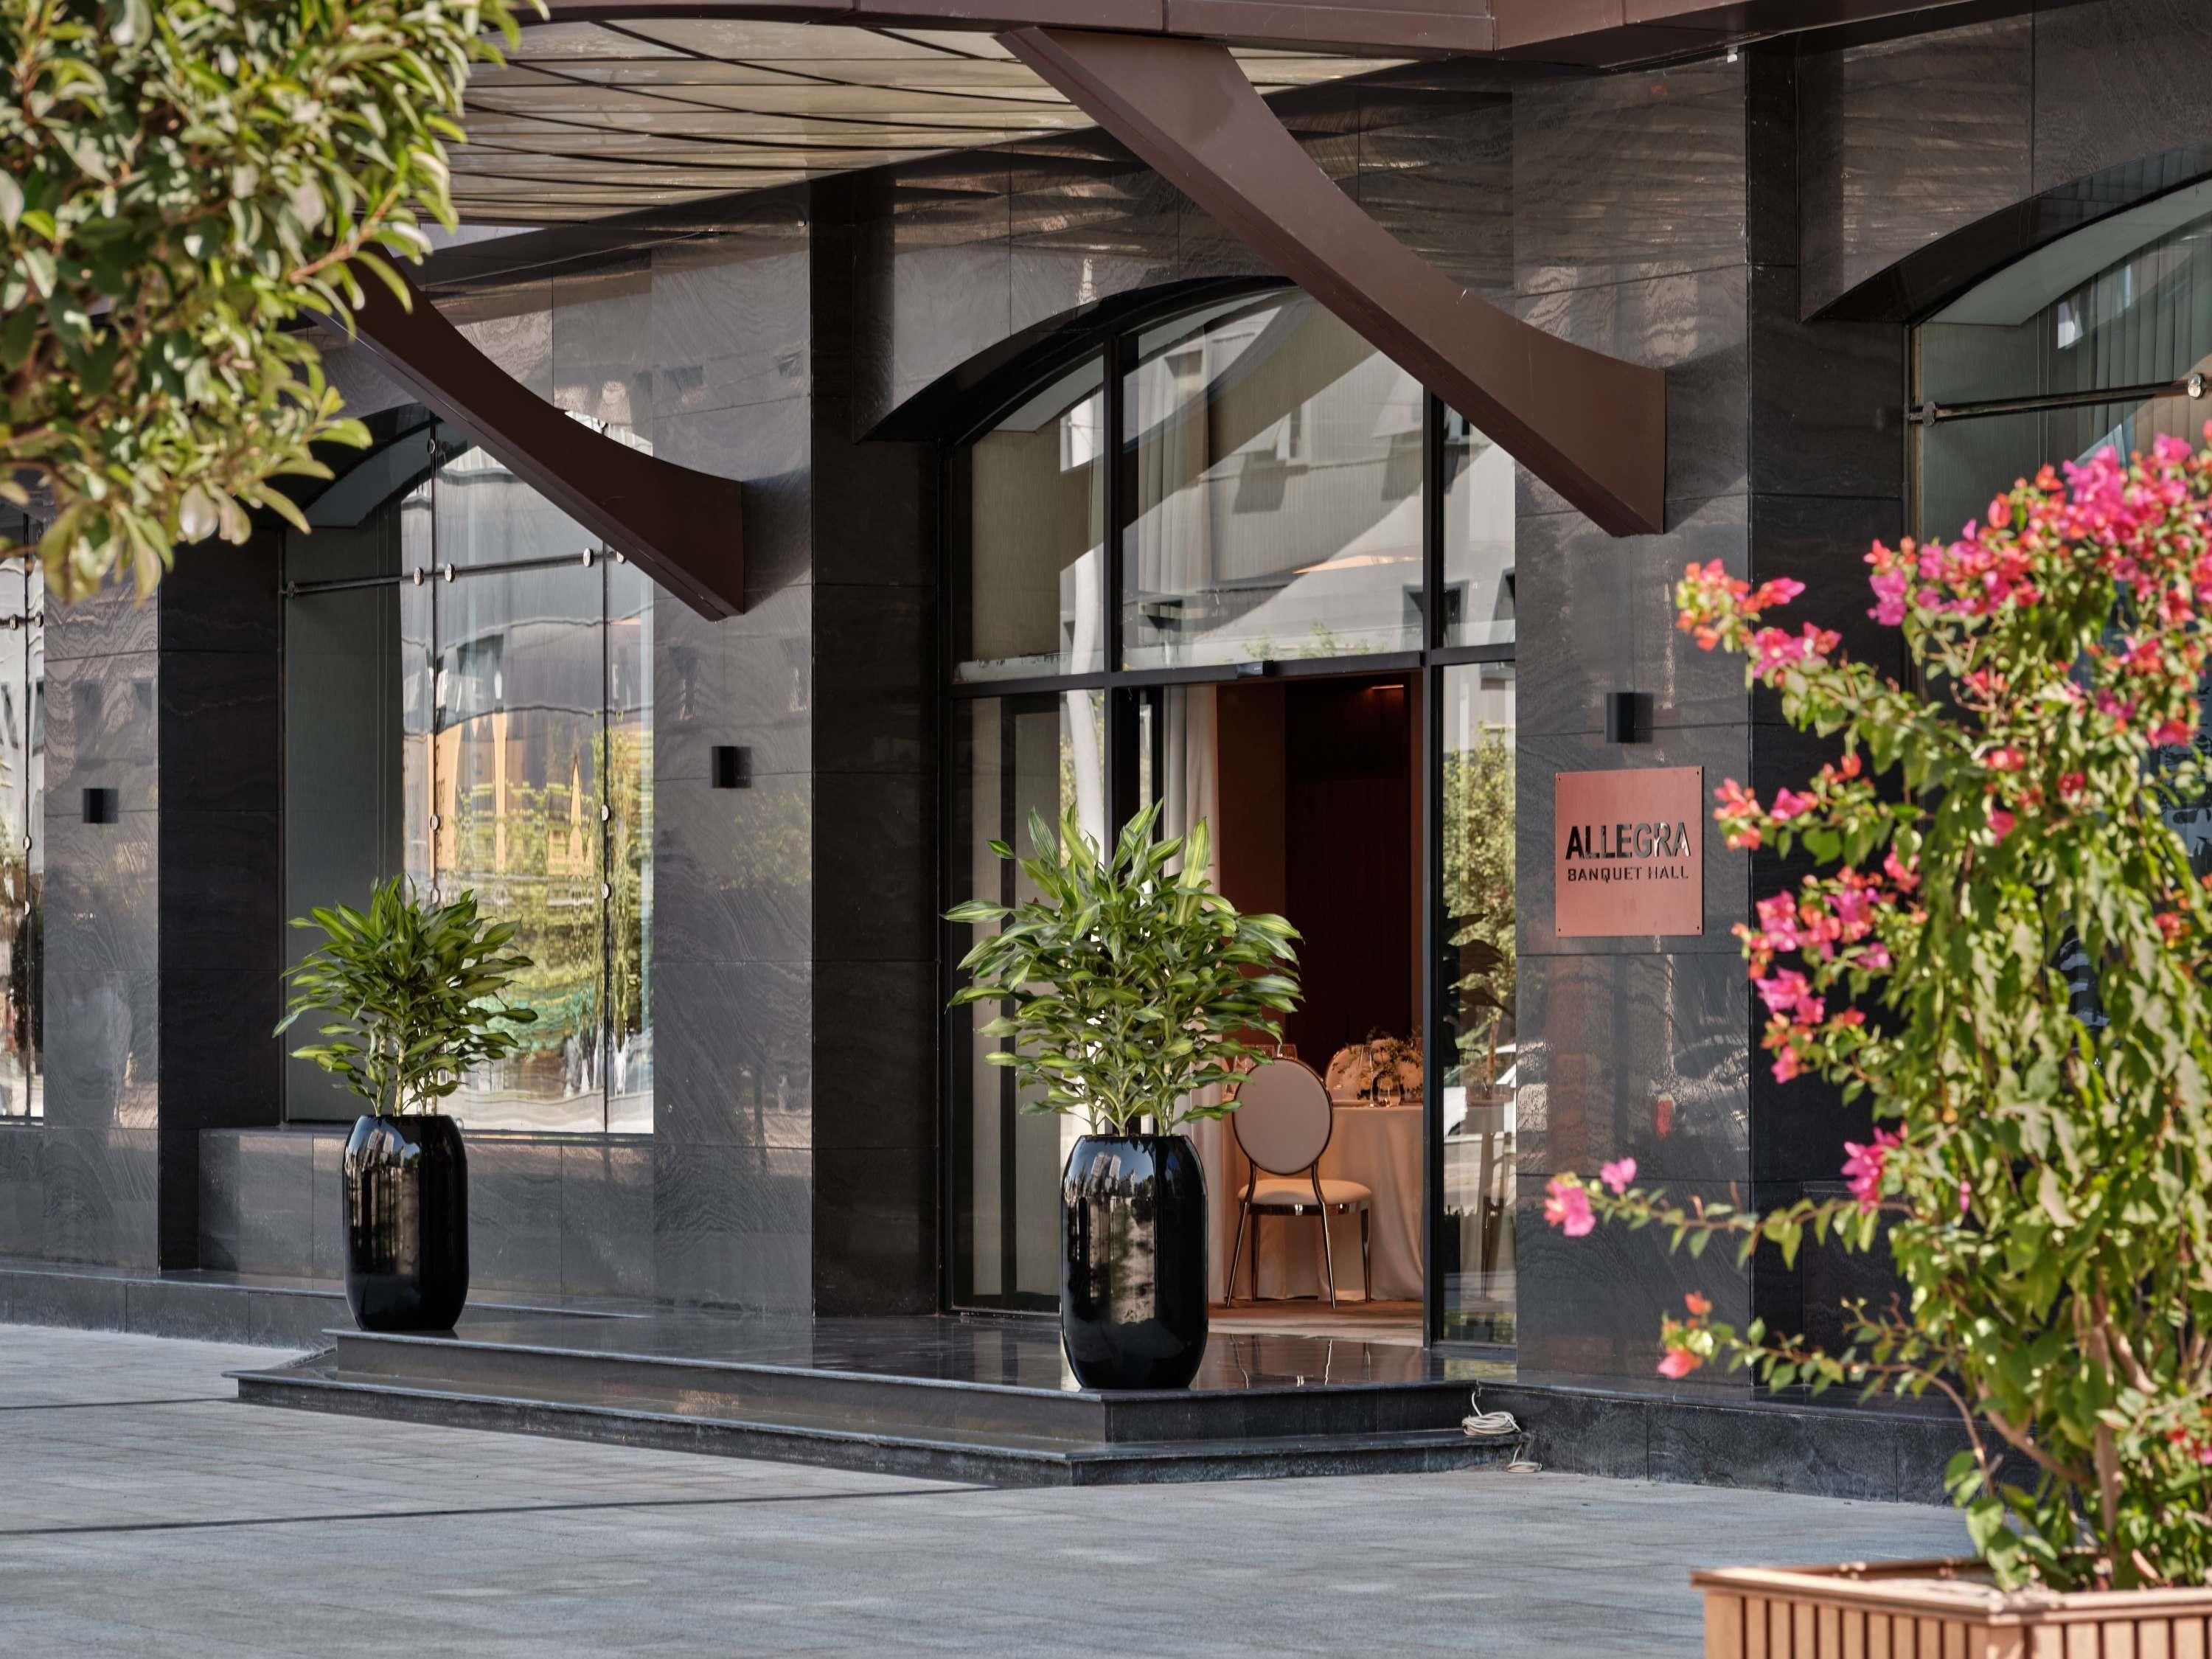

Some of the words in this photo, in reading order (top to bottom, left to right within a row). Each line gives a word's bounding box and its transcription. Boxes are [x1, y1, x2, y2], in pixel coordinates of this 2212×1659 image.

[1565, 822, 1691, 860] ALLEGRA
[1568, 866, 1642, 883] BANQUET
[1648, 866, 1688, 880] HALL
